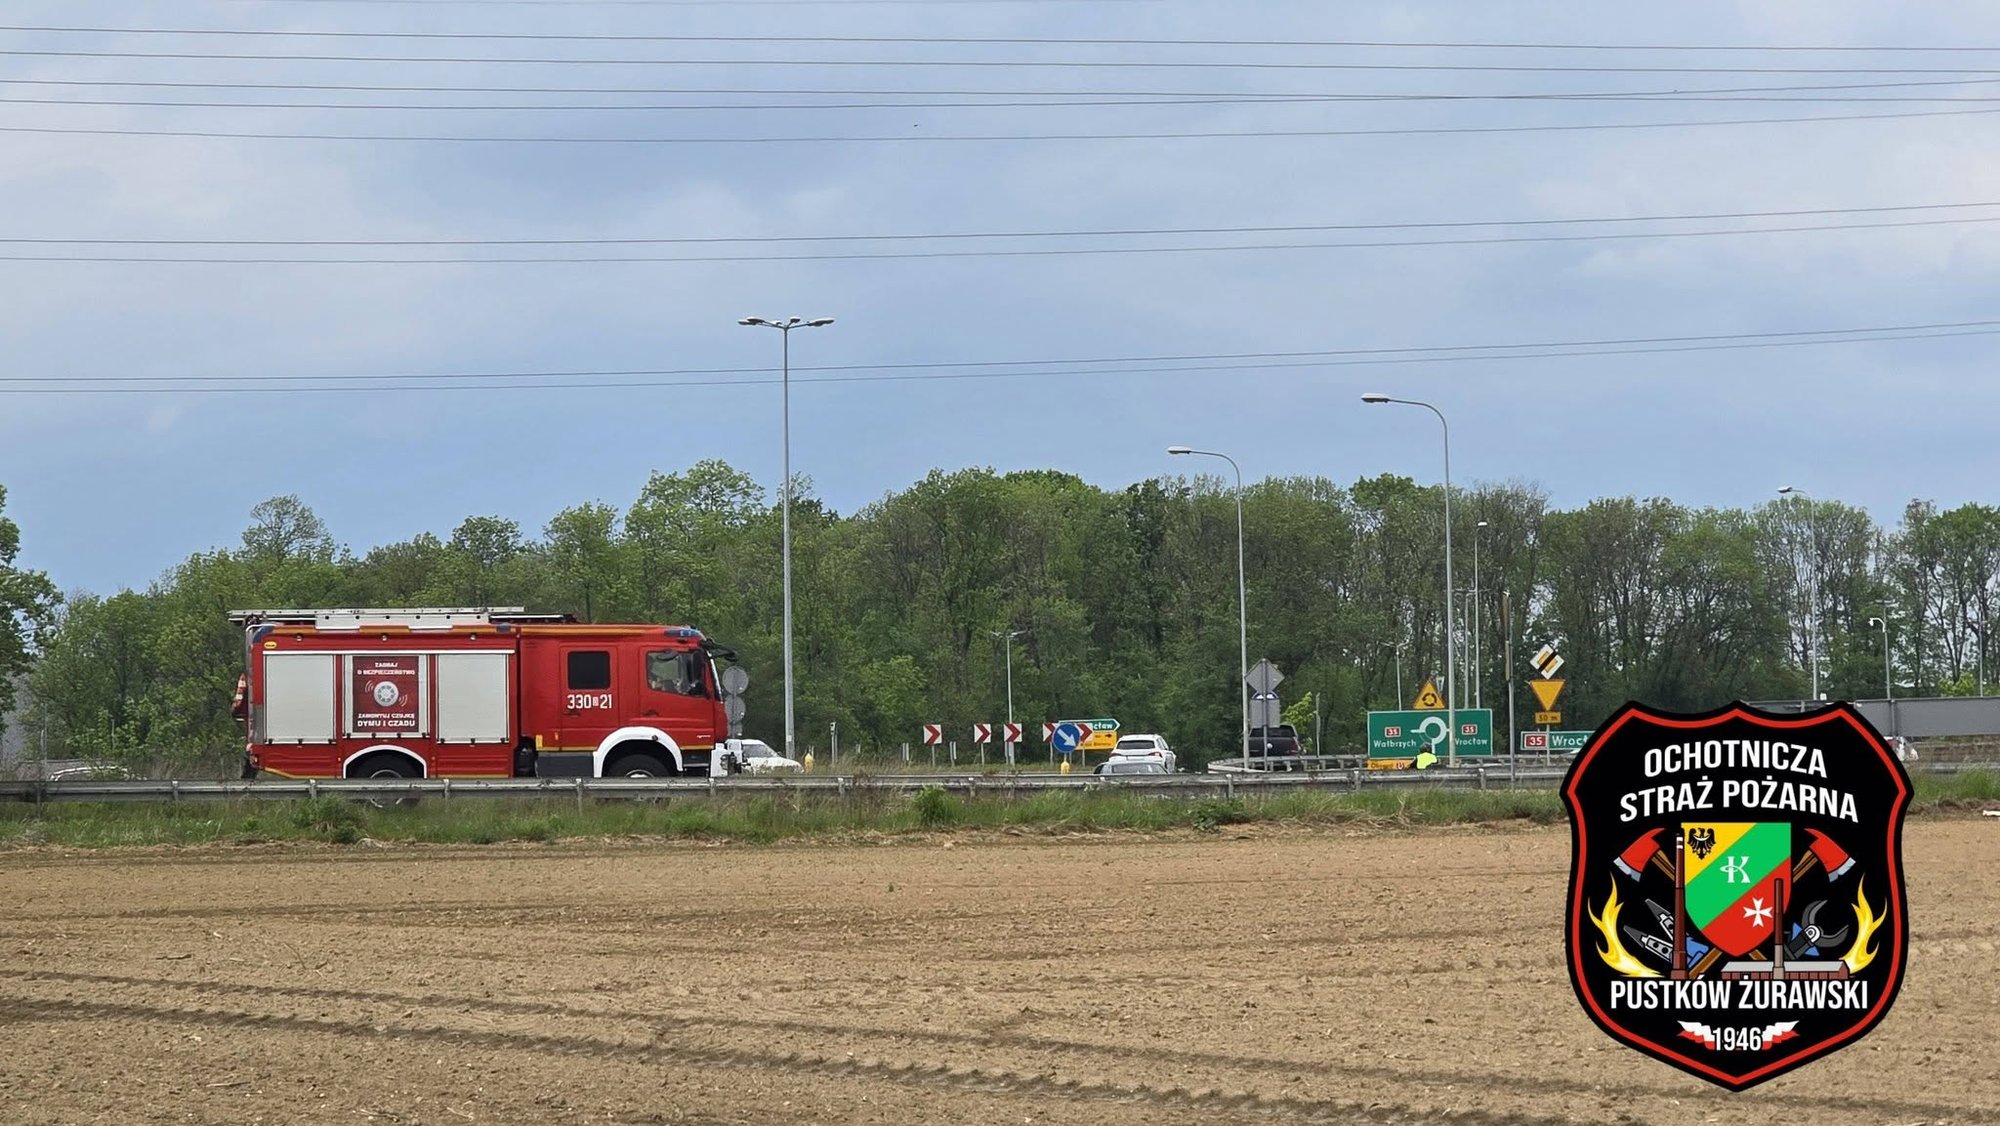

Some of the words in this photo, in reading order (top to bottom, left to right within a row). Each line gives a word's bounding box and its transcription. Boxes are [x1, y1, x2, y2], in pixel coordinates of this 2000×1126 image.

[567, 694, 592, 709] 330
[600, 694, 612, 709] 21
[1387, 728, 1398, 736] 35
[1464, 726, 1475, 734] 35
[1373, 739, 1417, 749] Wałbrzych
[1529, 736, 1543, 746] 35
[1552, 735, 1589, 747] Wrocł
